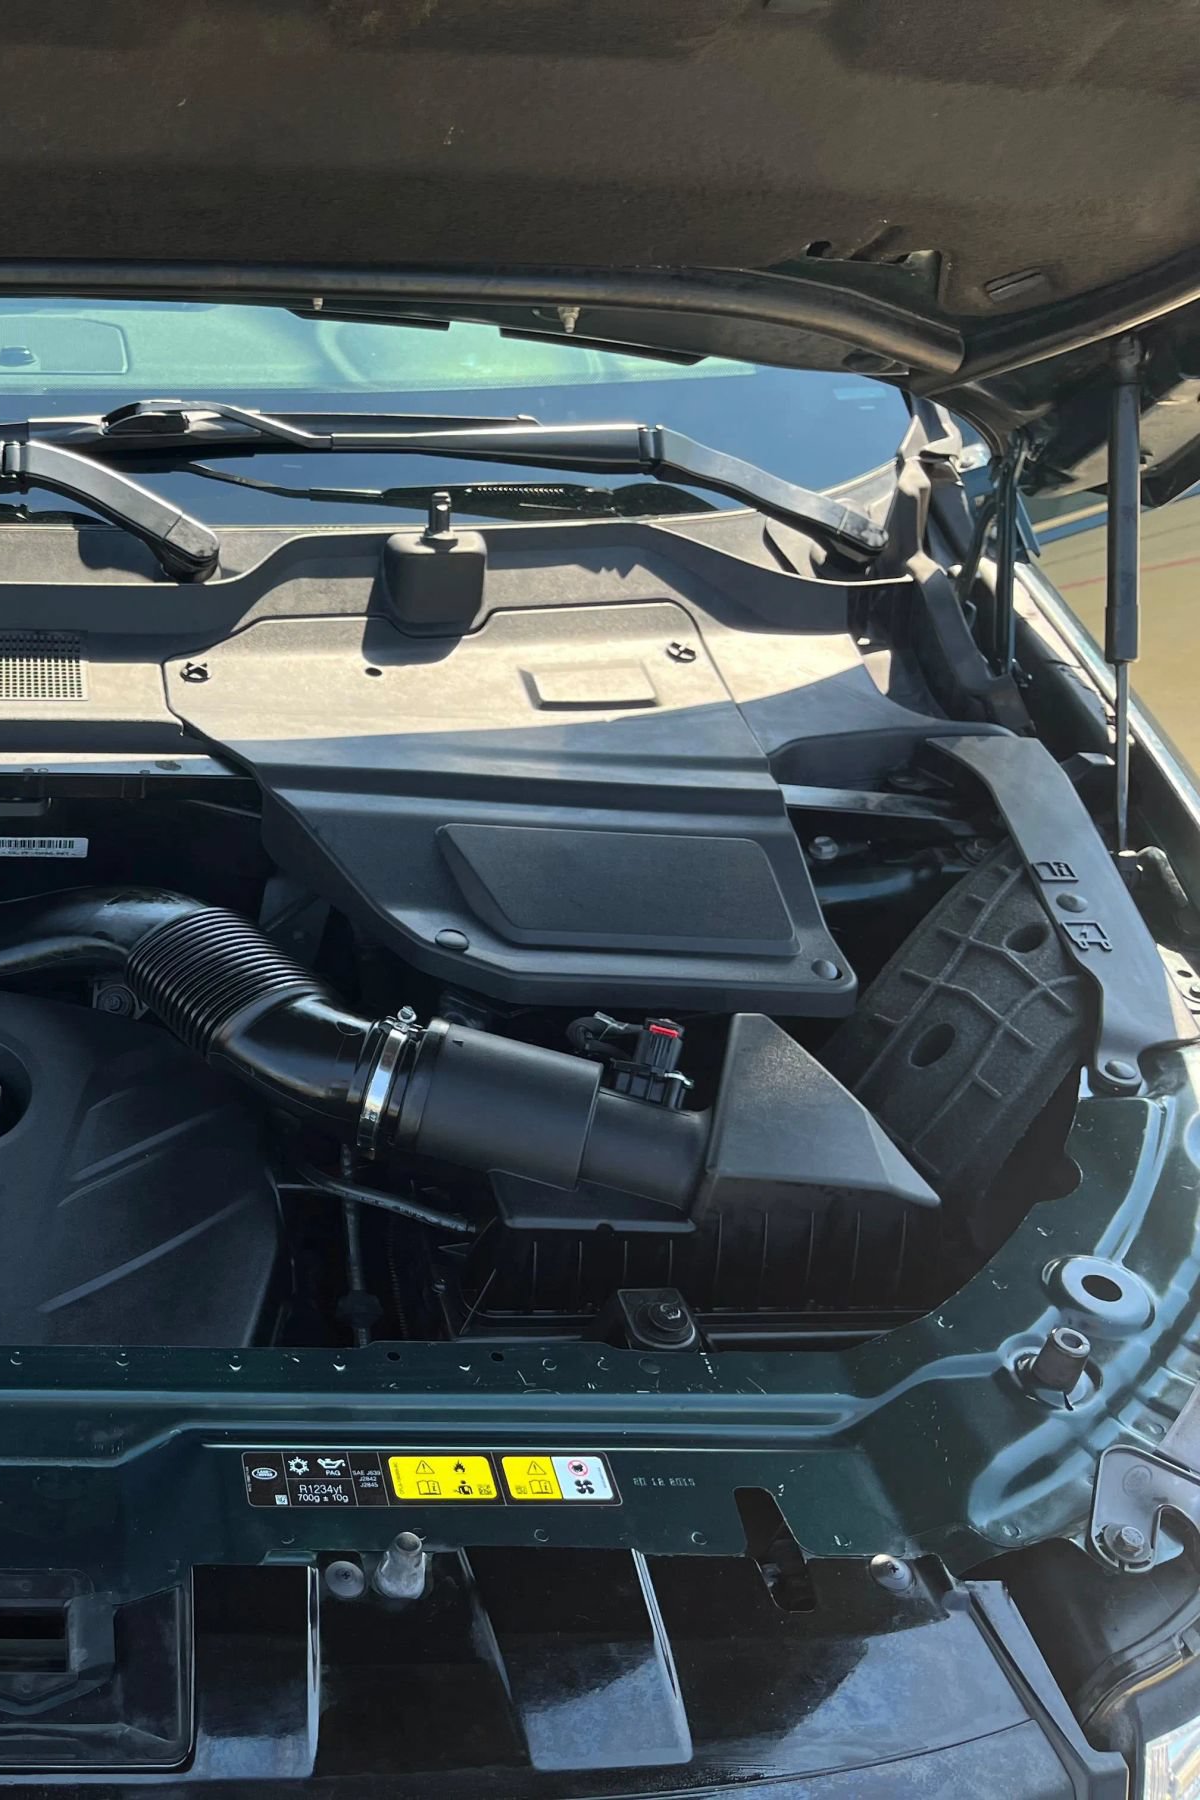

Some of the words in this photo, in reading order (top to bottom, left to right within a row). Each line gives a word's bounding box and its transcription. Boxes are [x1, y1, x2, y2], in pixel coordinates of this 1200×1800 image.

[299, 1484, 342, 1495] R1234yf
[297, 1493, 321, 1503] 700g
[332, 1494, 349, 1503] 10g
